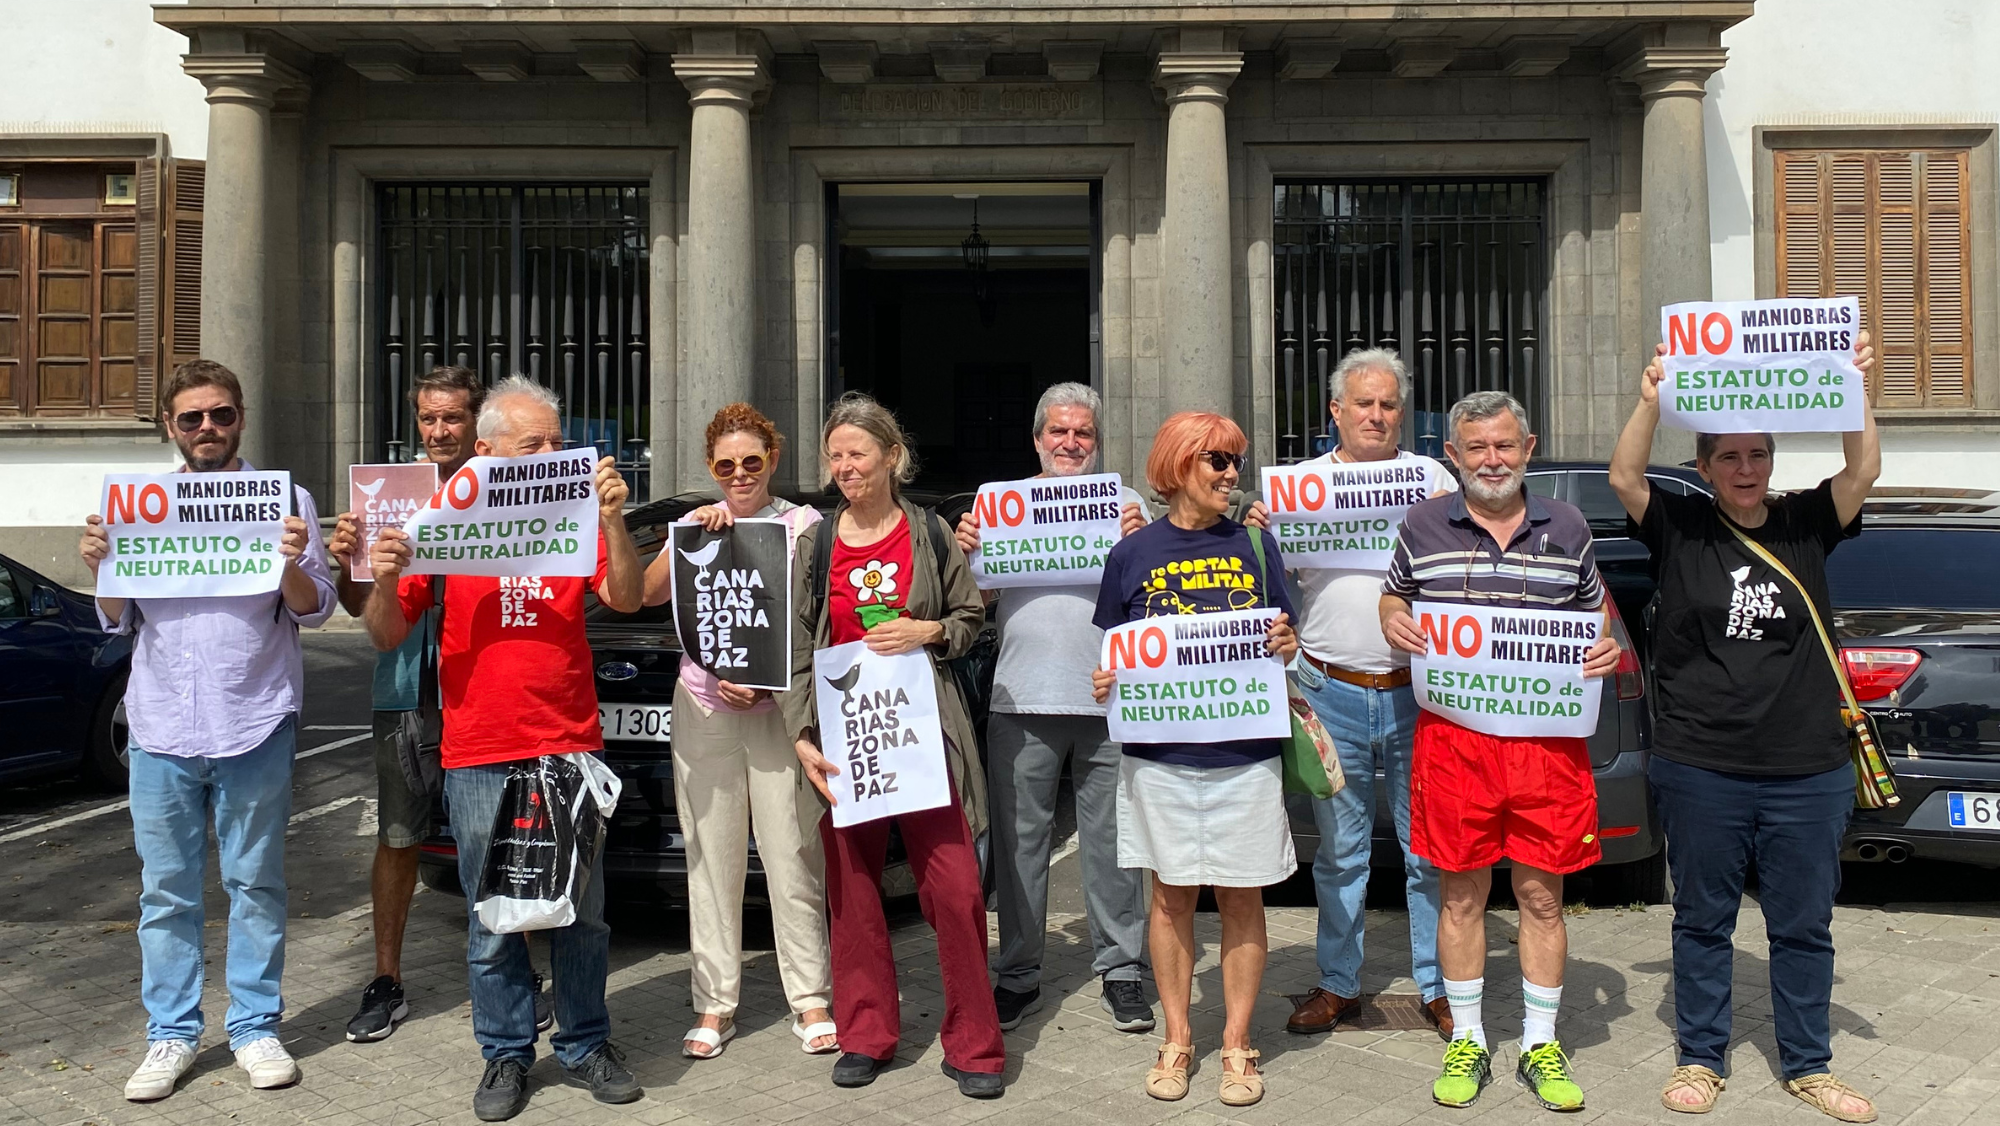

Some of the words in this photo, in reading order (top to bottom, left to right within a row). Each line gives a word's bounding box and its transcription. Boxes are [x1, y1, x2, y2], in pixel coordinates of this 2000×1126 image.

[957, 91, 986, 112] DEL
[1000, 91, 1082, 112] GOBIERNO
[1741, 306, 1851, 328] MANIOBRAS
[1669, 311, 1733, 356] NO
[1743, 330, 1851, 354] MILITARES
[1676, 367, 1809, 389] ESTATUTO
[1817, 369, 1844, 386] de
[1676, 391, 1844, 412] NEUTRALIDAD
[489, 457, 591, 483] MANIOBRAS
[1332, 465, 1425, 486] MANIOBRAS
[177, 480, 281, 499] MANIOBRAS
[487, 480, 590, 508] MILITARES
[1031, 481, 1118, 503] MANIOBRAS
[1269, 473, 1326, 513] NO
[1334, 487, 1426, 509] MILITARES
[106, 483, 169, 525] NO
[178, 502, 281, 522] MILITARES
[365, 498, 418, 513] CANA
[974, 489, 1026, 529] NO
[1032, 501, 1120, 525] MILITARES
[366, 513, 408, 526] RIAS
[417, 518, 547, 542] ESTATUTO
[554, 517, 579, 532] de
[1279, 518, 1389, 538] ESTATUTO
[117, 536, 241, 555] ESTATUTO
[250, 538, 273, 552] de
[415, 538, 579, 560] NEUTRALIDAD
[982, 534, 1086, 557] ESTATUTO
[1093, 535, 1113, 549] de
[115, 558, 272, 577] NEUTRALIDAD
[500, 576, 543, 588] RIAS
[694, 568, 764, 592] CANA
[1181, 573, 1255, 590] MILITAR
[1734, 580, 1781, 598] CANA
[500, 586, 555, 601] ZONA
[696, 589, 754, 611] RIAS
[1731, 589, 1775, 609] RIAS
[501, 600, 525, 615] DE
[1728, 602, 1786, 619] ZONA
[501, 612, 538, 628] PAZ
[696, 609, 769, 632] ZONA
[1175, 617, 1273, 640] MANIOBRAS
[1491, 616, 1596, 640] MANIOBRAS
[1728, 614, 1754, 629] DE
[698, 628, 732, 650] DE
[1420, 612, 1483, 659] NO
[1725, 626, 1764, 641] PAZ
[700, 647, 749, 669] PAZ
[1109, 626, 1168, 670] NO
[1177, 640, 1274, 666] MILITARES
[1119, 677, 1237, 700] ESTATUTO
[1245, 677, 1268, 693] de
[1426, 668, 1551, 695] ESTATUTO
[1559, 681, 1584, 697] de
[841, 687, 910, 718] CANA
[1121, 699, 1271, 722] NEUTRALIDAD
[1427, 689, 1583, 717] NEUTRALIDAD
[845, 709, 900, 739] RIAS
[846, 727, 919, 761] ZONA
[850, 755, 880, 782] DE
[853, 772, 899, 803] PAZ
[1954, 812, 1962, 821] E
[1973, 797, 2000, 823] 6
